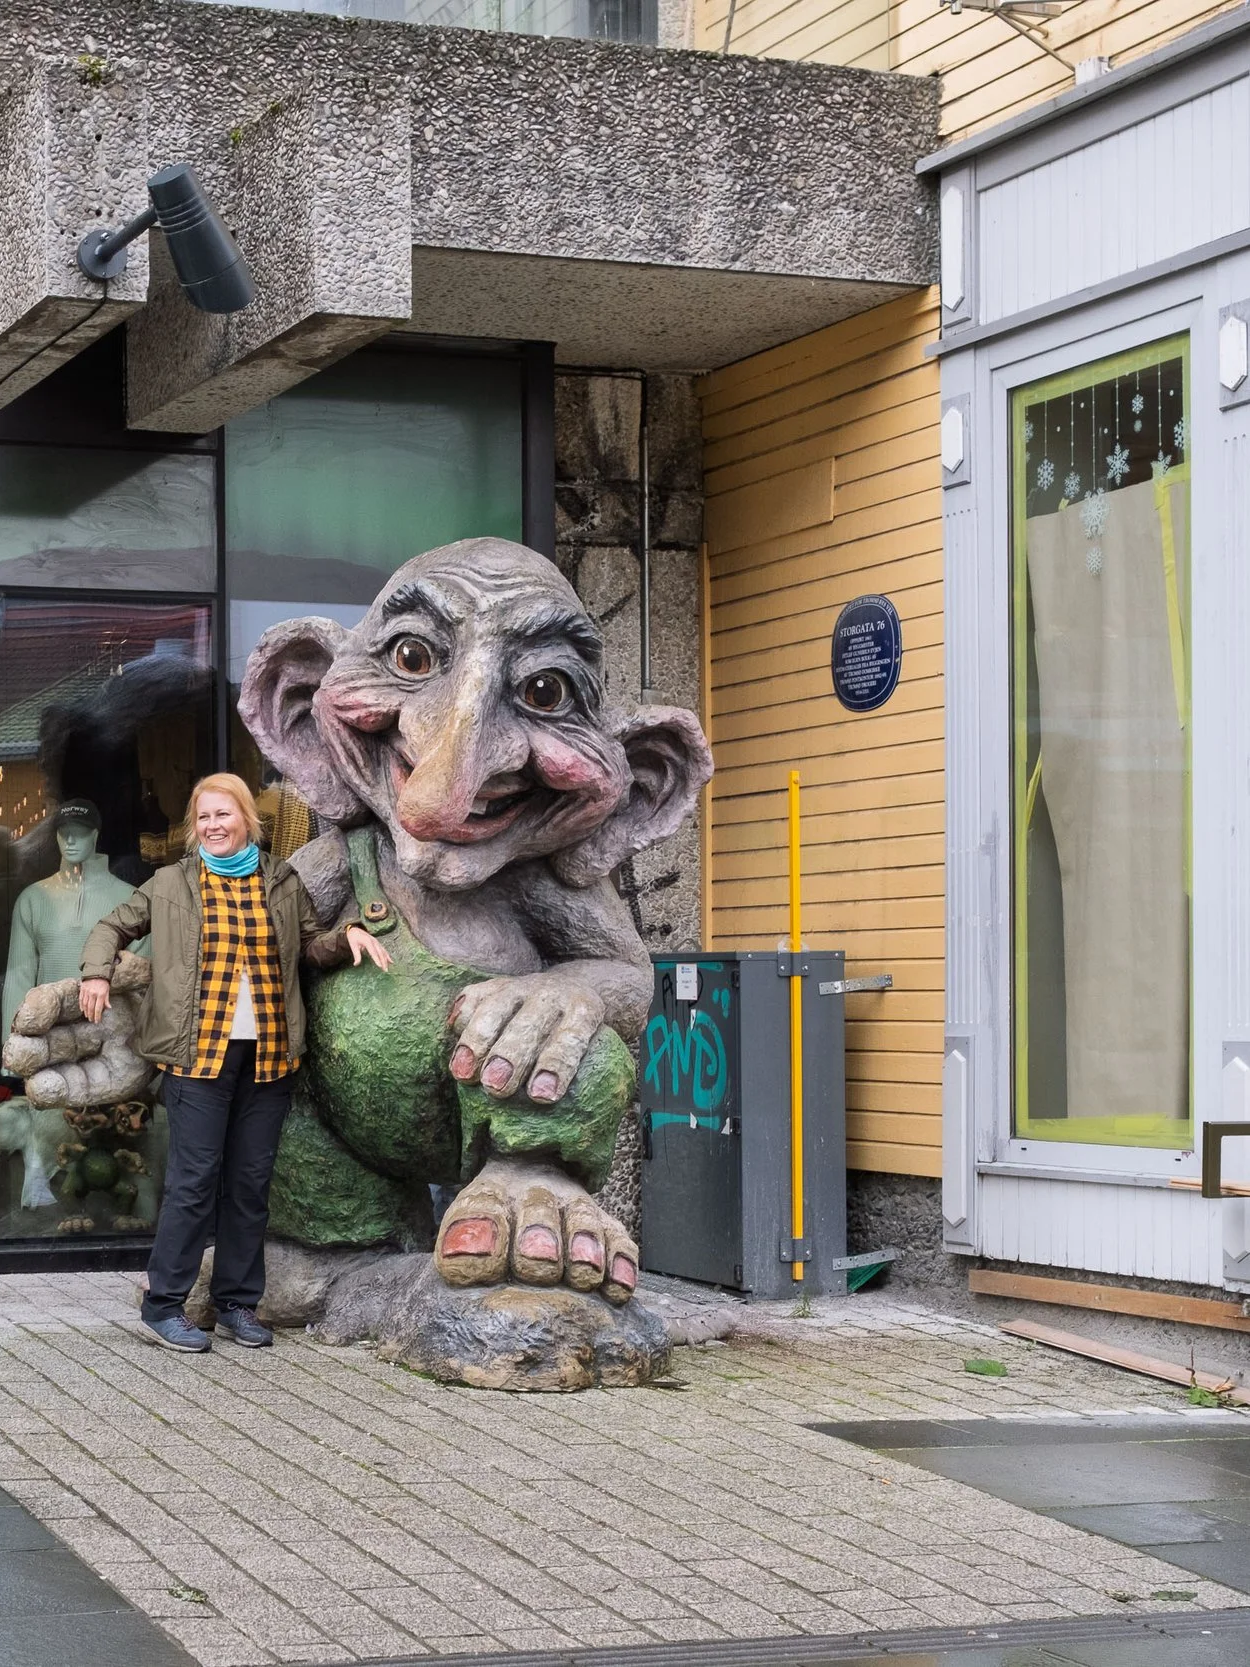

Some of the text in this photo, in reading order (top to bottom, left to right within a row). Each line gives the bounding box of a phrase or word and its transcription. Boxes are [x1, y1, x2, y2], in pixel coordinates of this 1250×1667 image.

[840, 620, 885, 637] STORGATA 76
[60, 806, 89, 815] Norway
